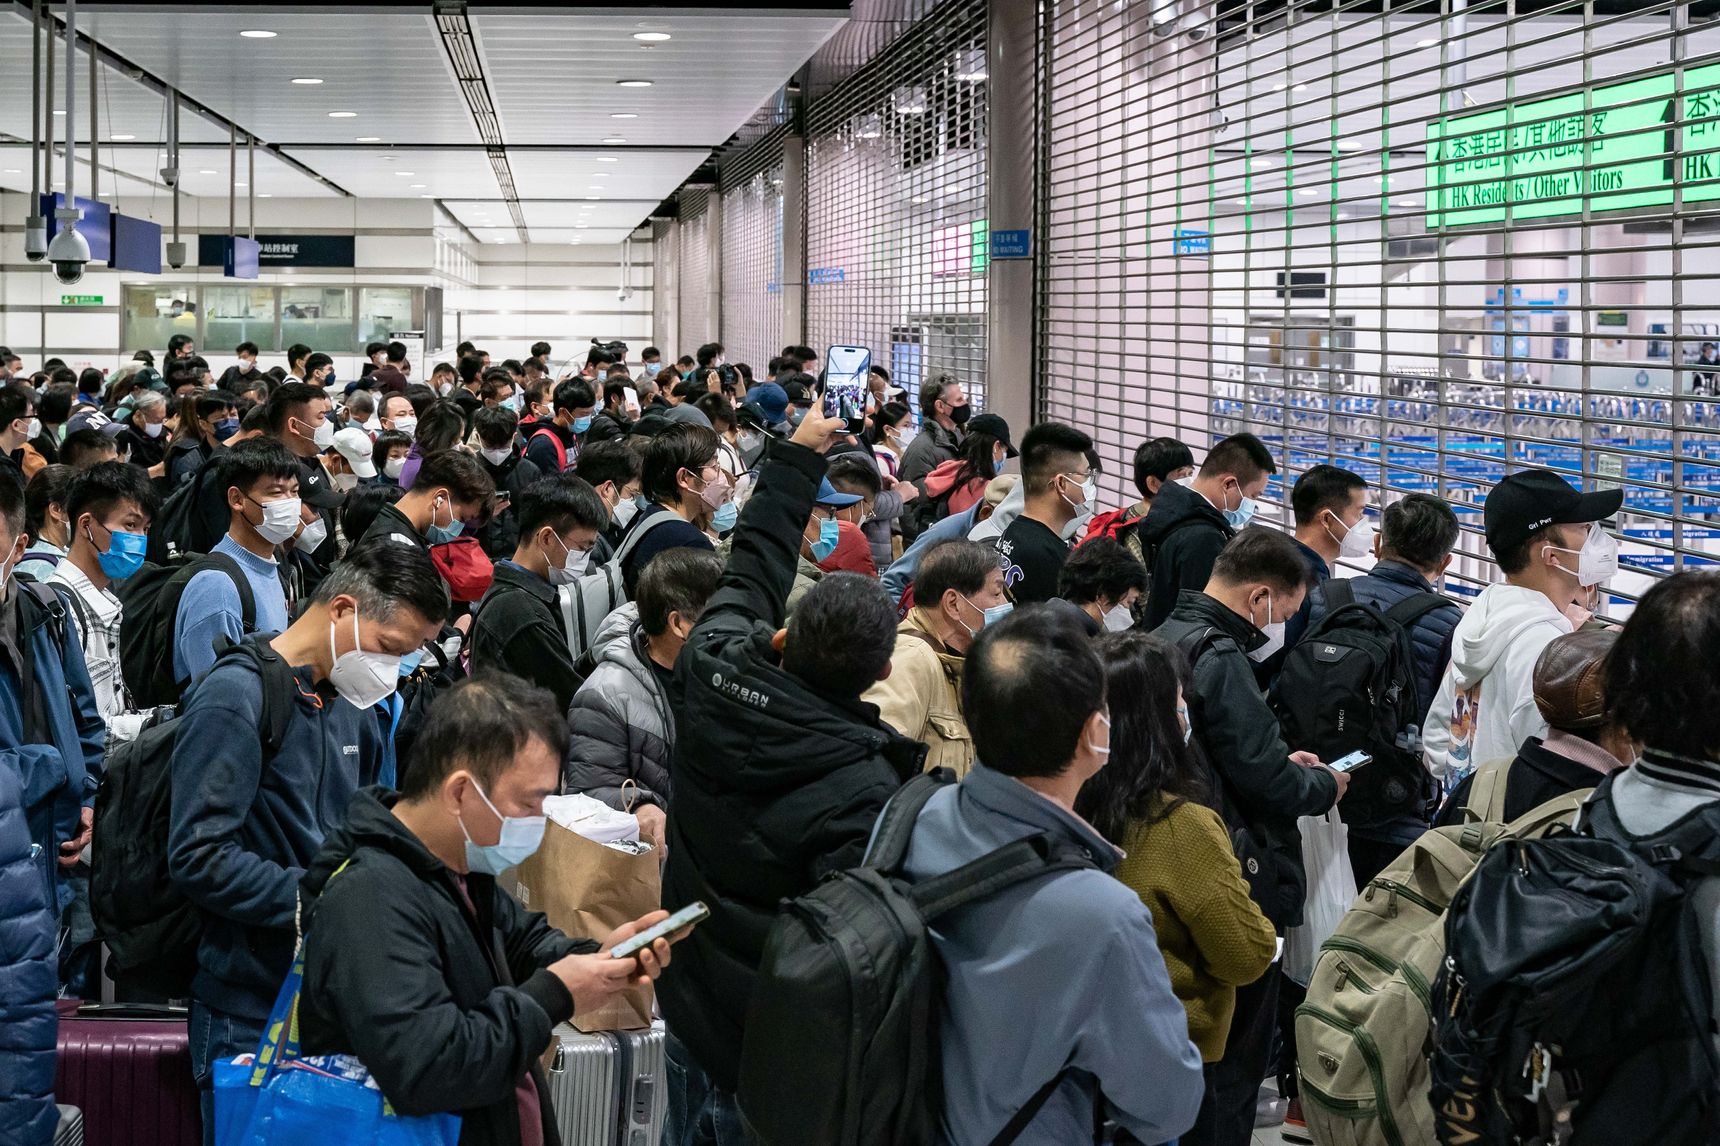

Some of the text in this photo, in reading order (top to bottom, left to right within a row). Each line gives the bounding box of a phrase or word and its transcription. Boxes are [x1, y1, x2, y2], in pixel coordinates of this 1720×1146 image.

[1685, 155, 1712, 180] HK
[1452, 186, 1469, 208] HK
[1473, 181, 1524, 206] Residets
[1534, 173, 1569, 199] Other
[1573, 169, 1623, 194] Vitors
[722, 678, 769, 704] URBAN
